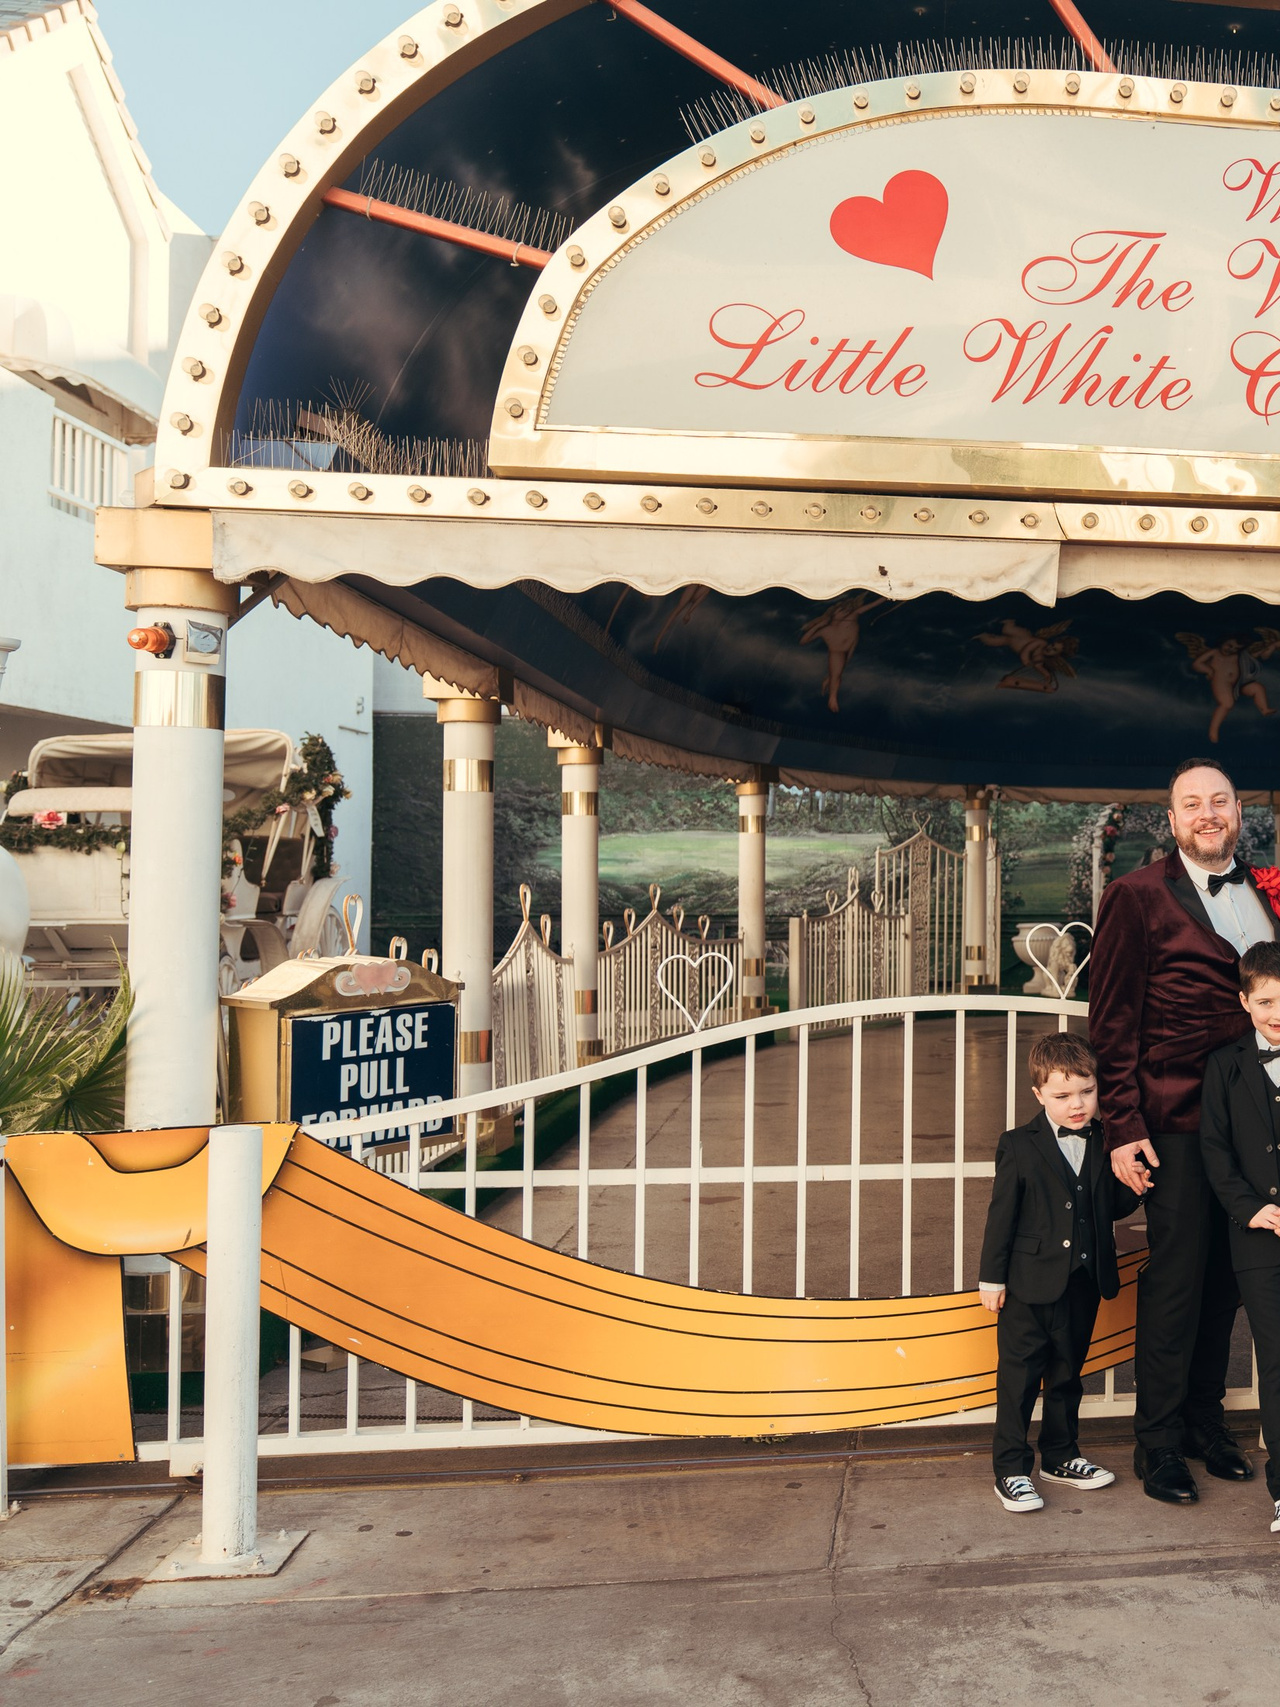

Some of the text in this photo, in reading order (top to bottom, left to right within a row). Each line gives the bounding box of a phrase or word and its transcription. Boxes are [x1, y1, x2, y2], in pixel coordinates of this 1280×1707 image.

[1021, 230, 1194, 312] The
[694, 303, 928, 397] Little
[963, 318, 1193, 410] White
[322, 1012, 428, 1060] PLEASE
[340, 1058, 409, 1102] PULL
